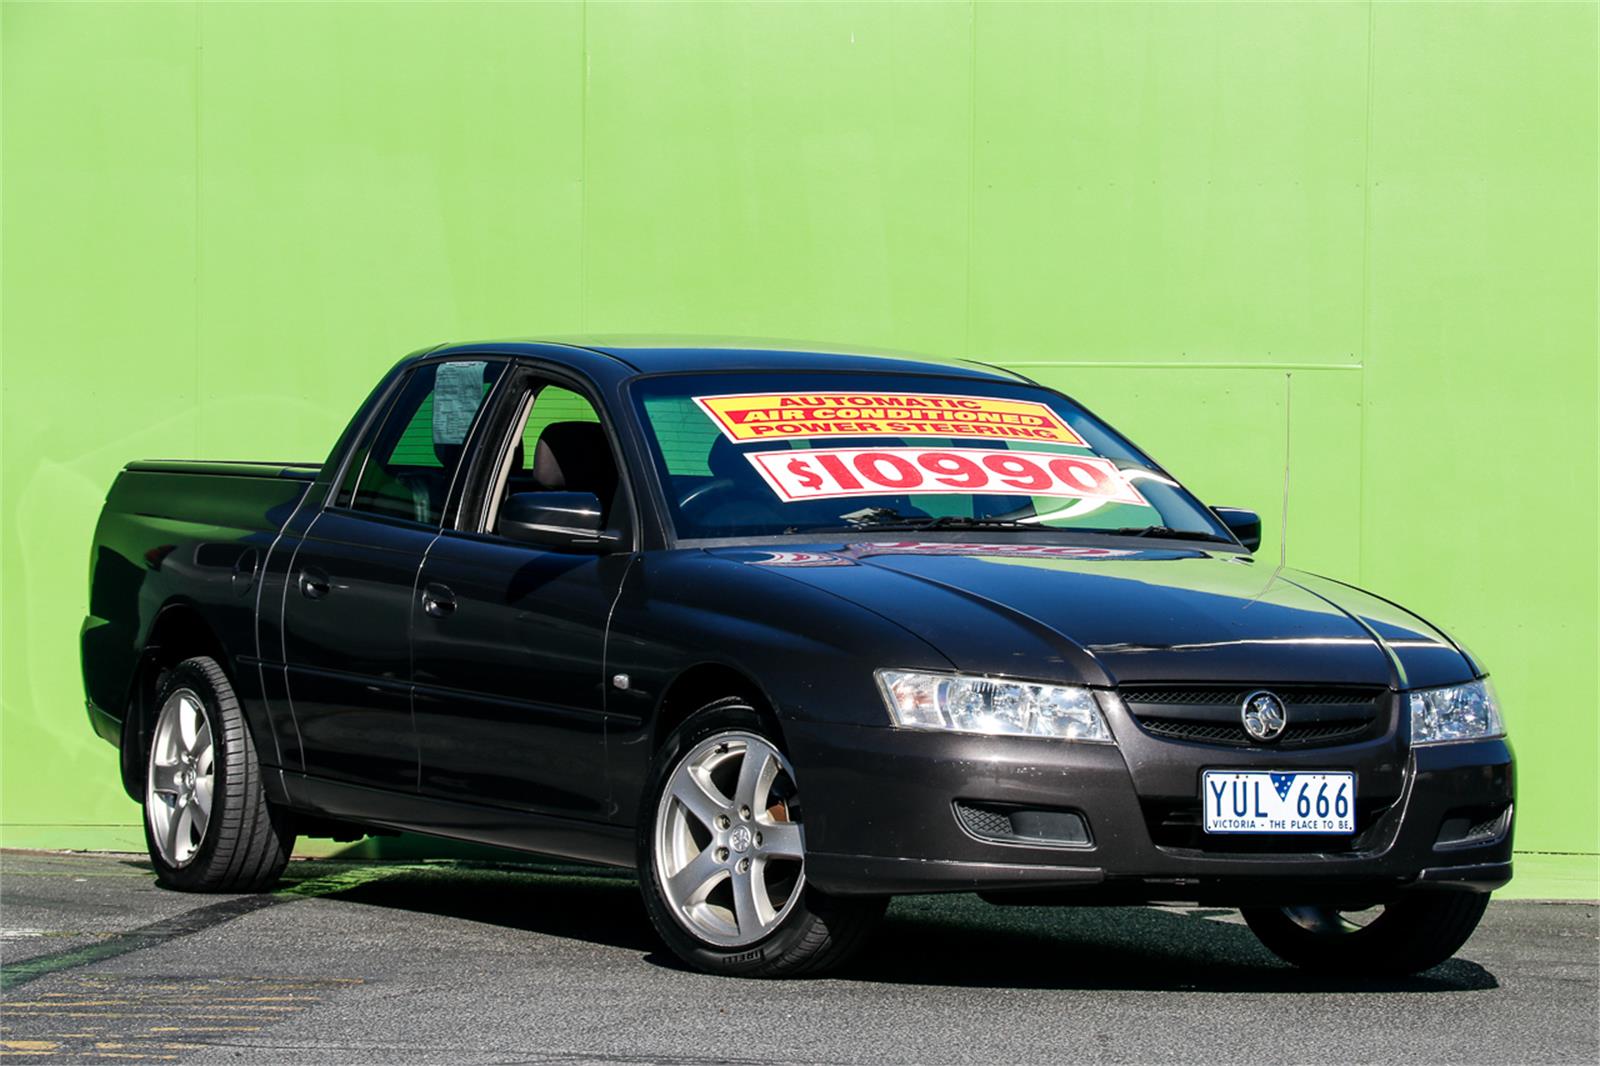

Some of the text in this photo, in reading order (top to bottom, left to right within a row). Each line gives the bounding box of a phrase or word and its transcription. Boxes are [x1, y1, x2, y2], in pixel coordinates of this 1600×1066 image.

[780, 396, 982, 410] AUTOMATIC
[742, 408, 1044, 427] AIR CONDITIONED
[750, 422, 1059, 440] POWER STEERING
[786, 452, 1114, 496] $10990
[1210, 780, 1348, 818] YUL 666
[1212, 819, 1256, 829] VICTORIA
[1269, 819, 1286, 829] THE
[1291, 820, 1318, 830] PLACE
[1323, 820, 1334, 830] TO
[1338, 820, 1349, 830] BE
